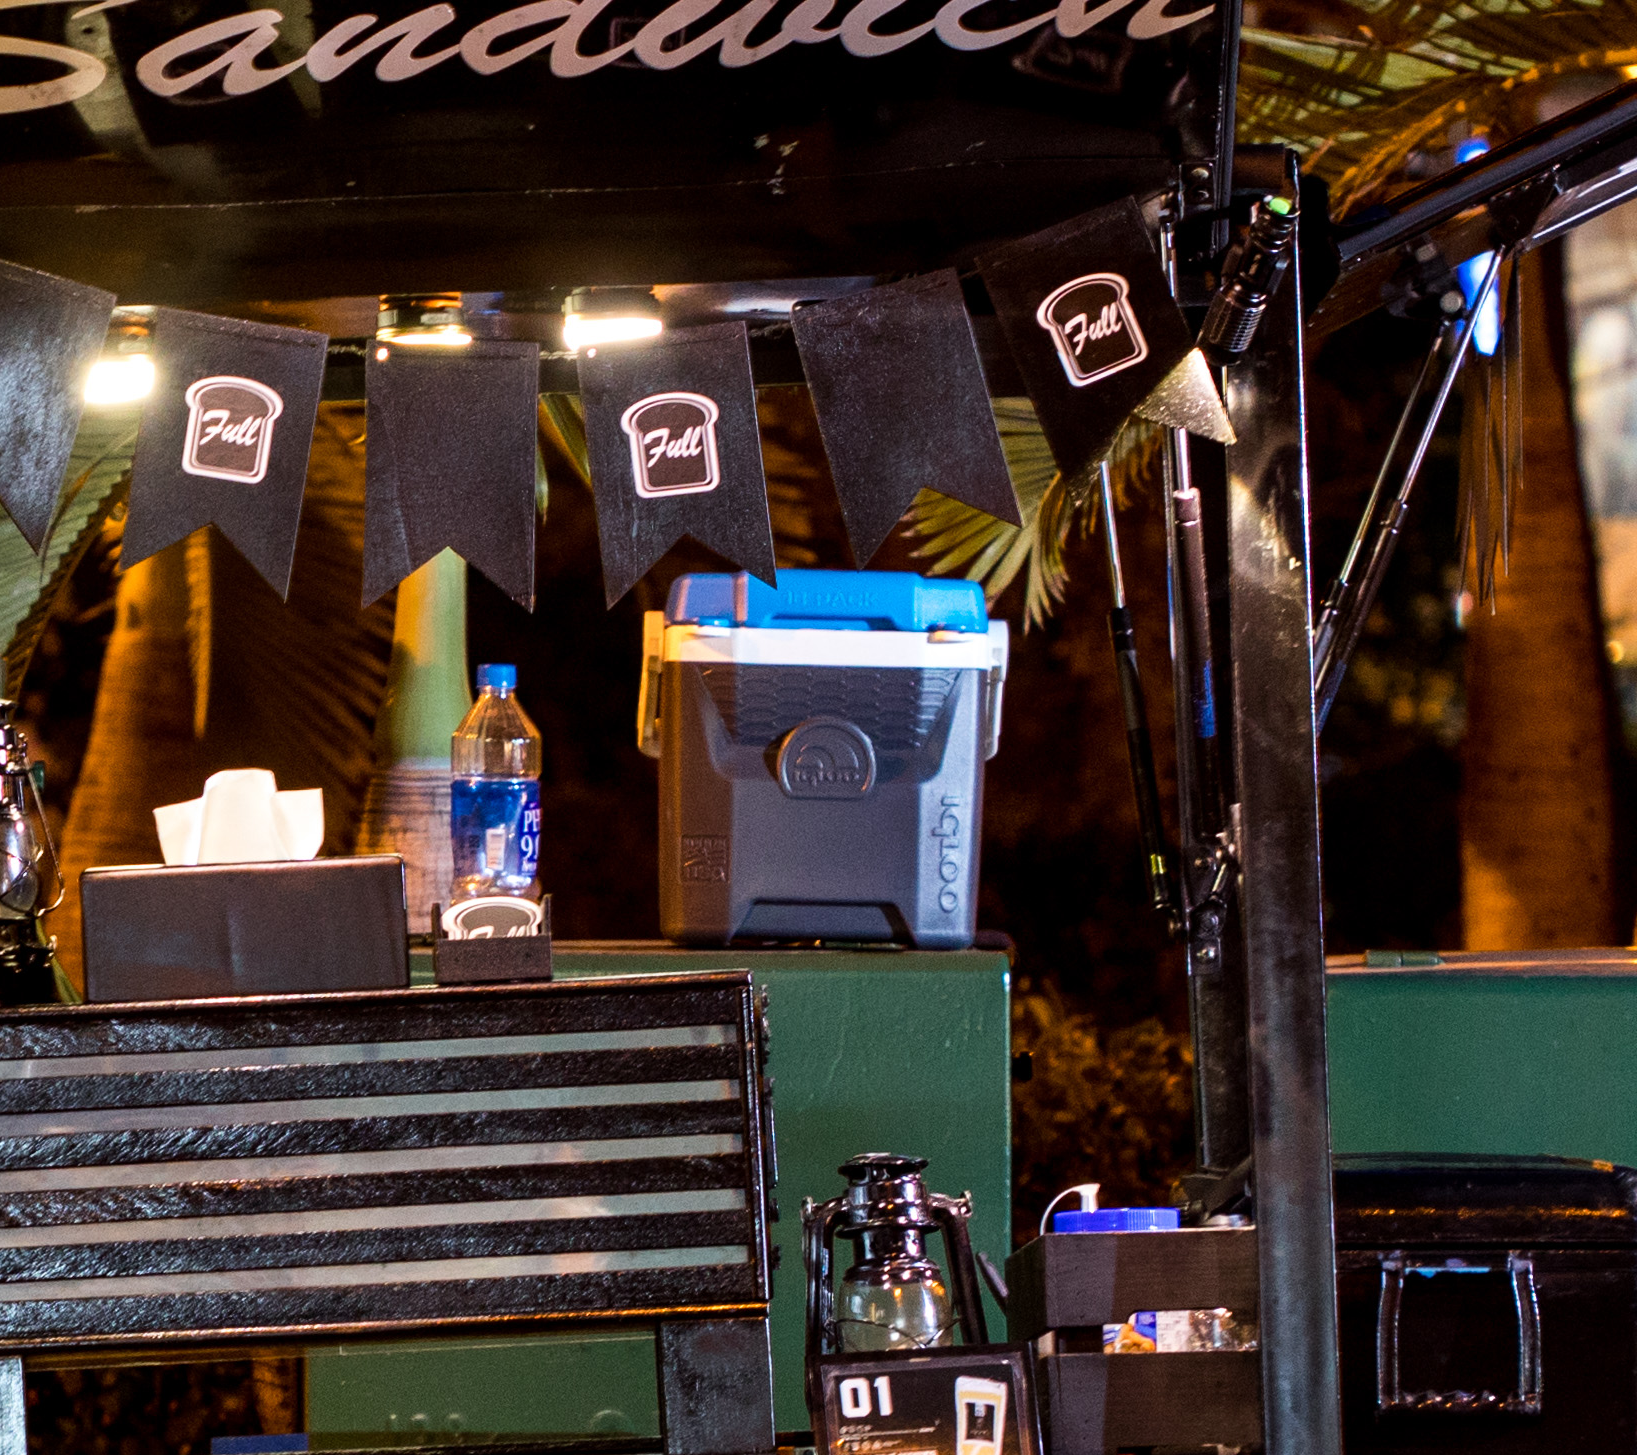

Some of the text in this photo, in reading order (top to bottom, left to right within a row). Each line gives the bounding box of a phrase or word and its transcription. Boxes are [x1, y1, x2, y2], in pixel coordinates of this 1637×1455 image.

[1063, 306, 1129, 352] Full
[200, 406, 265, 450] Full
[642, 420, 707, 466] Full
[839, 1375, 894, 1419] 01
